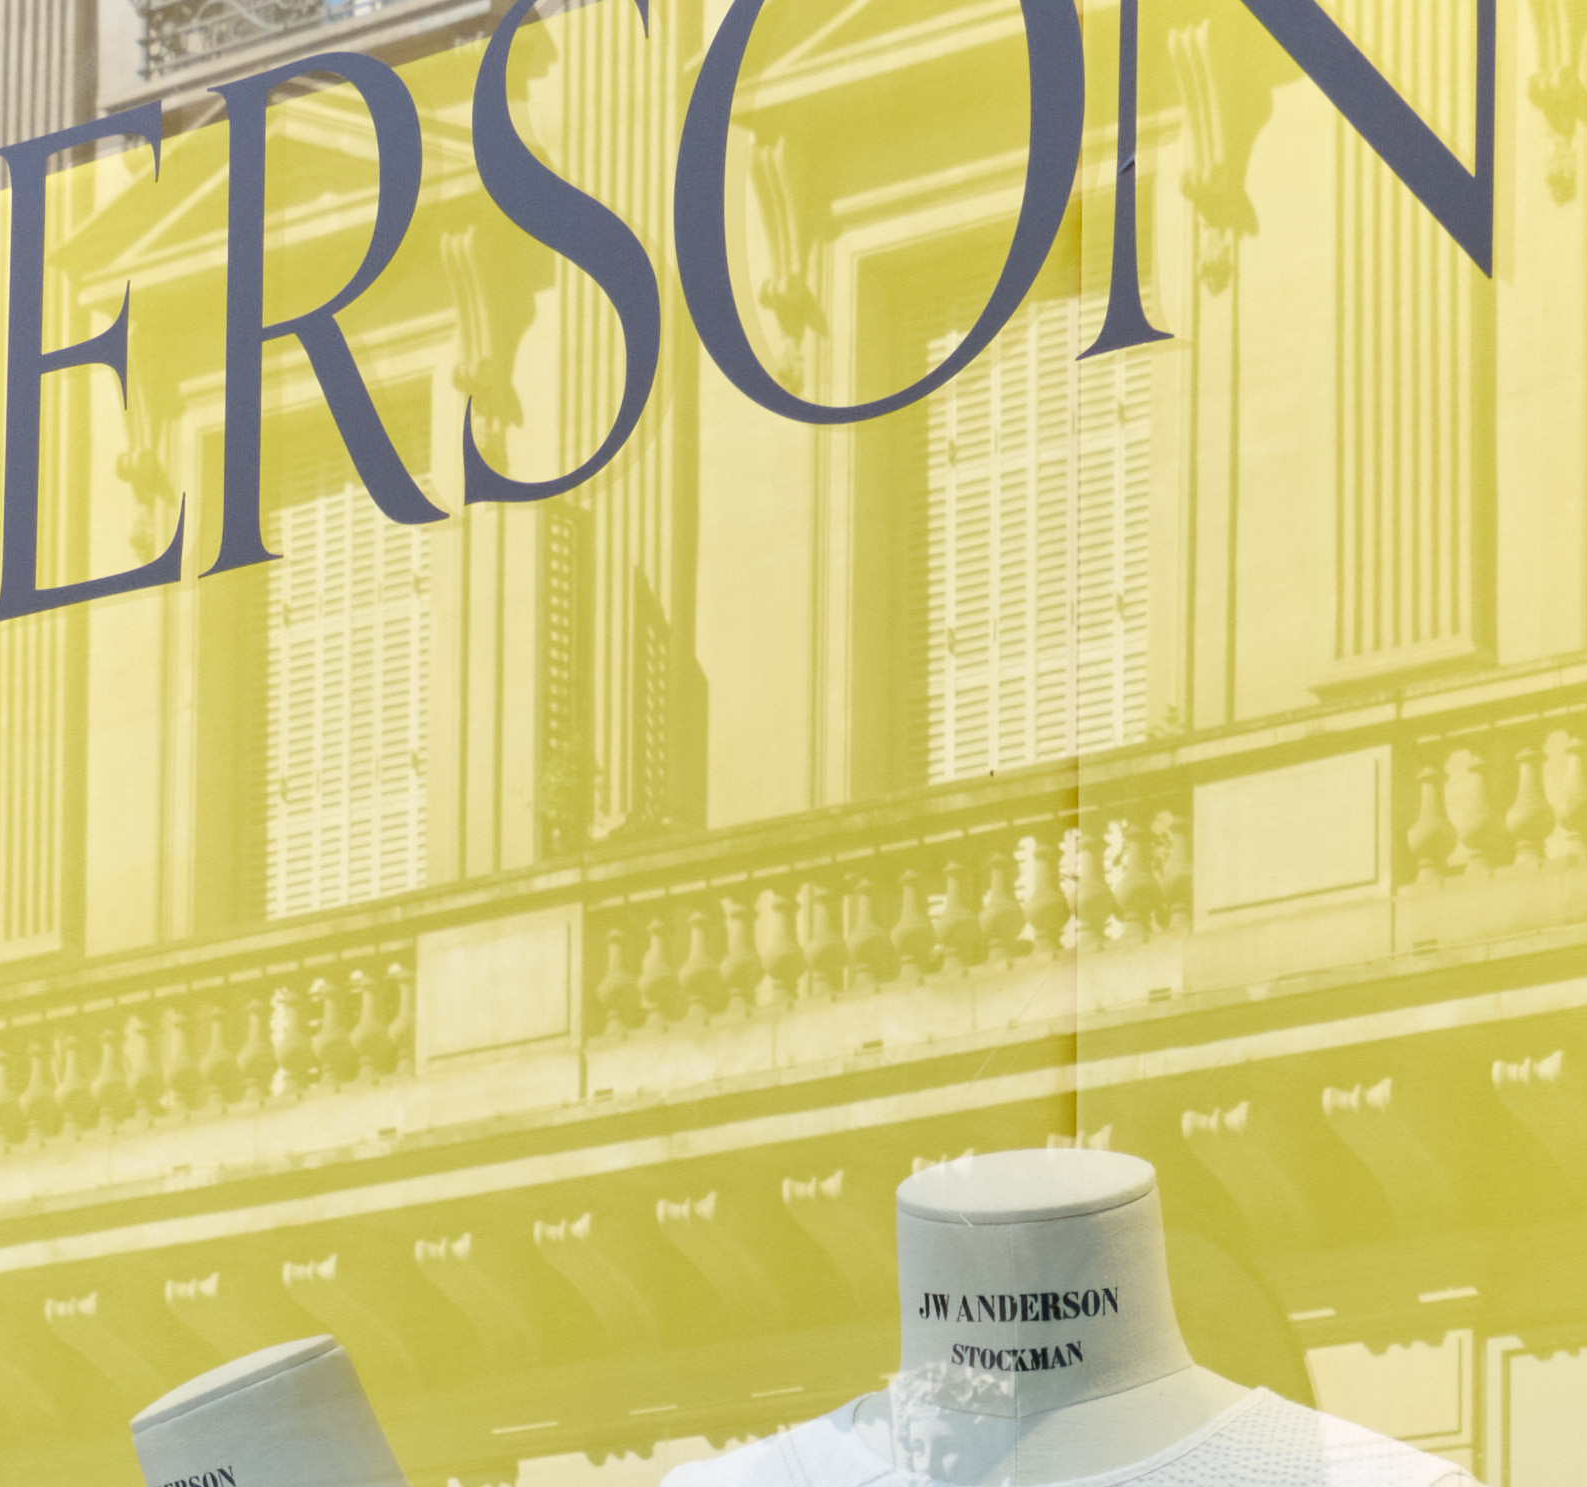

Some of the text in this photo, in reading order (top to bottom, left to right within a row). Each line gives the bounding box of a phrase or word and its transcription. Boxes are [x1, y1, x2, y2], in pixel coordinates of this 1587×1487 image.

[919, 1286, 1119, 1323] JW ANDERSON
[951, 1340, 1084, 1372] STOCKMAN
